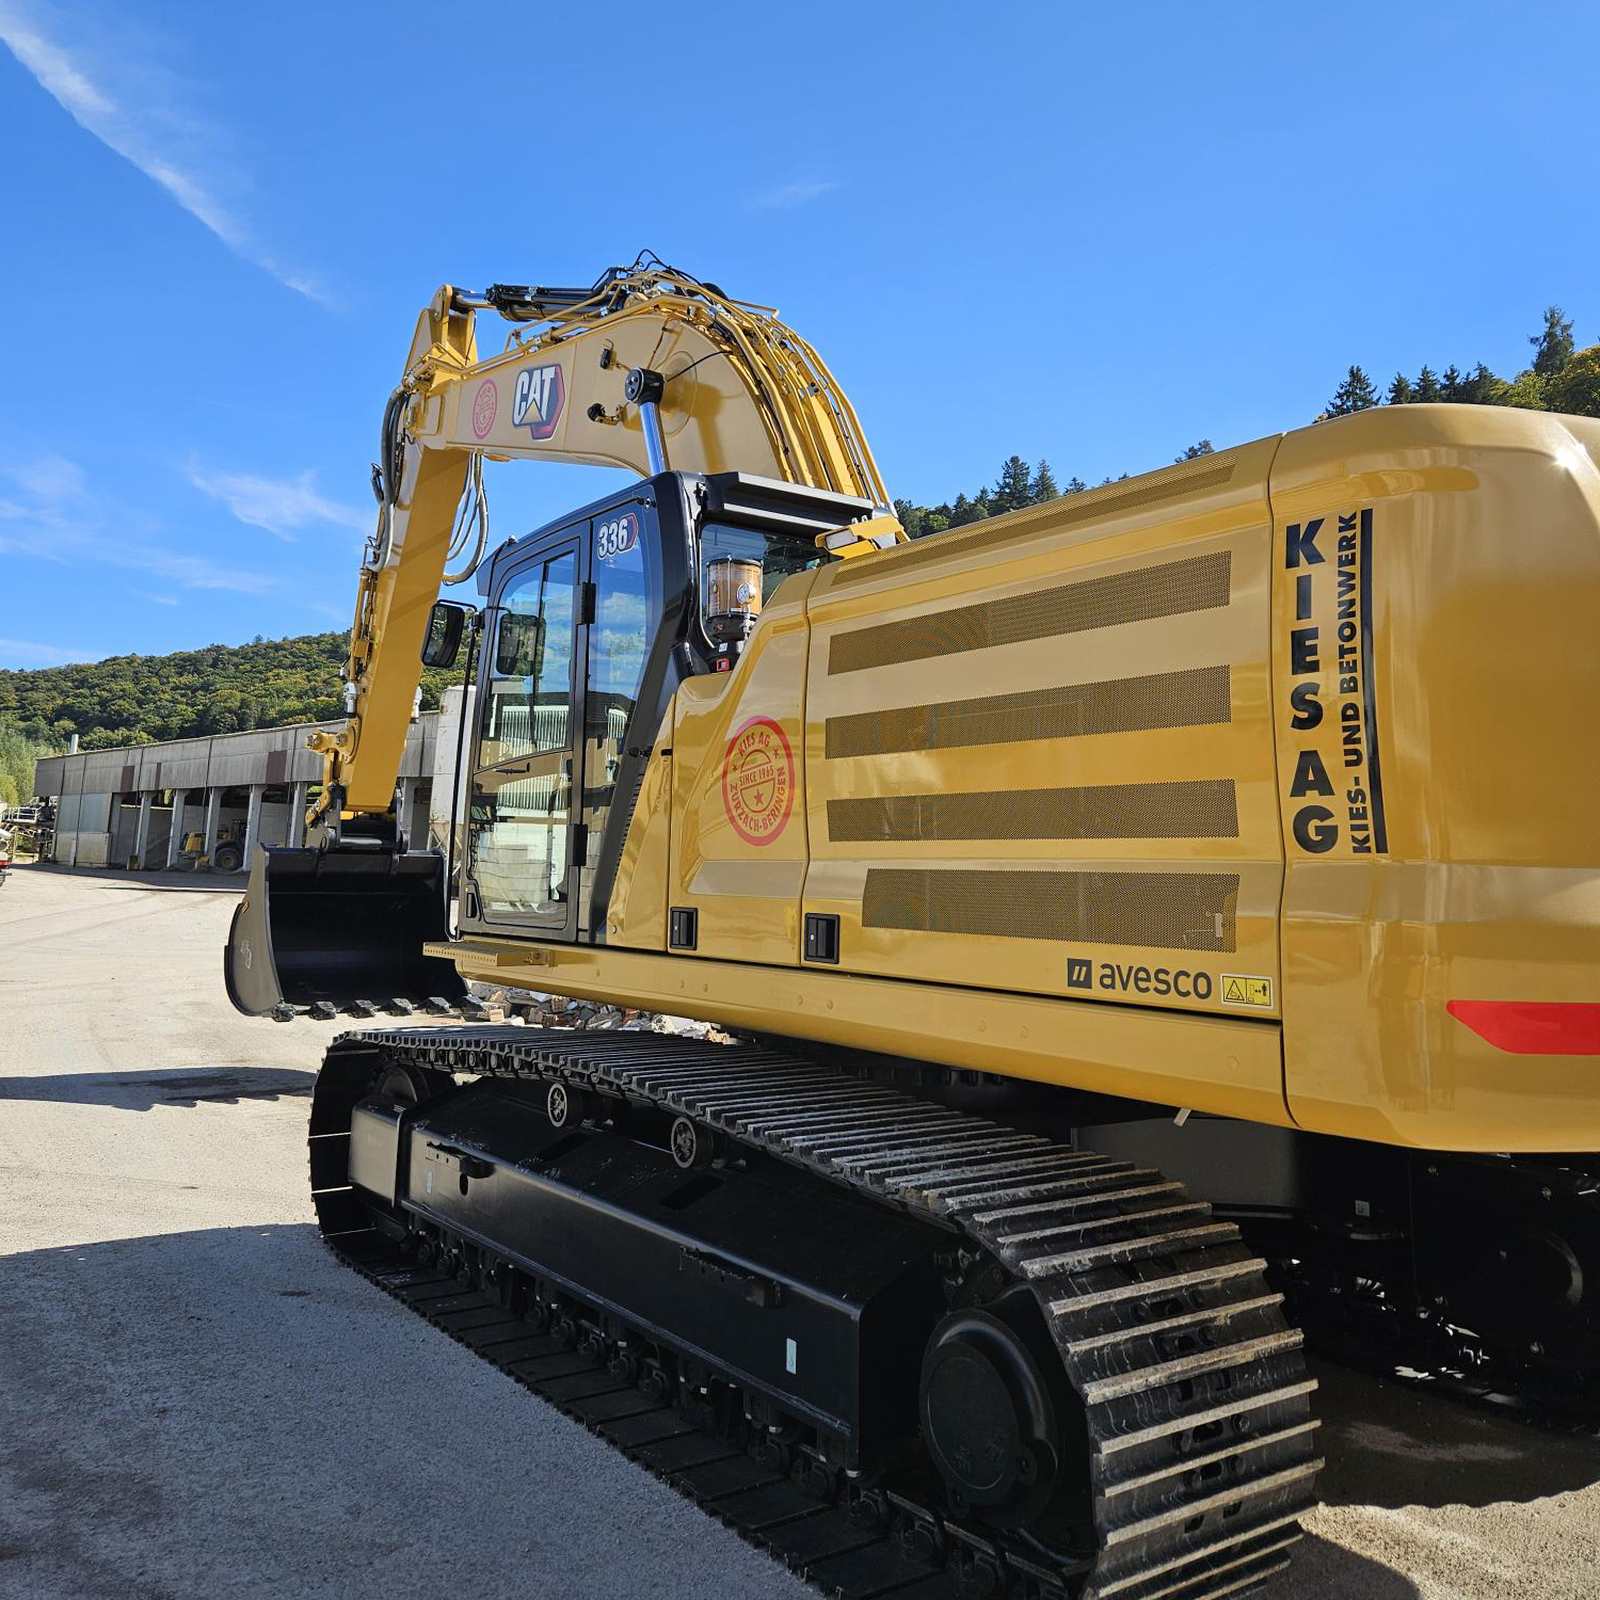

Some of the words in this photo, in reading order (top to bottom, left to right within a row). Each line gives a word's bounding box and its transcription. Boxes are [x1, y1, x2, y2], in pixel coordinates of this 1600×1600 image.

[513, 366, 556, 425] CAT
[598, 518, 629, 557] 336
[1285, 517, 1326, 731] KIES
[1337, 510, 1359, 695] BETONWERK
[738, 731, 756, 758] KIES
[758, 731, 771, 748] AG
[1340, 702, 1365, 768] UND
[730, 765, 786, 833] ZURZACH-BERINGEN
[739, 770, 758, 786] SINCE
[1289, 749, 1339, 854] AG
[1347, 776, 1372, 854] KIES-
[1099, 963, 1213, 1000] avesco
